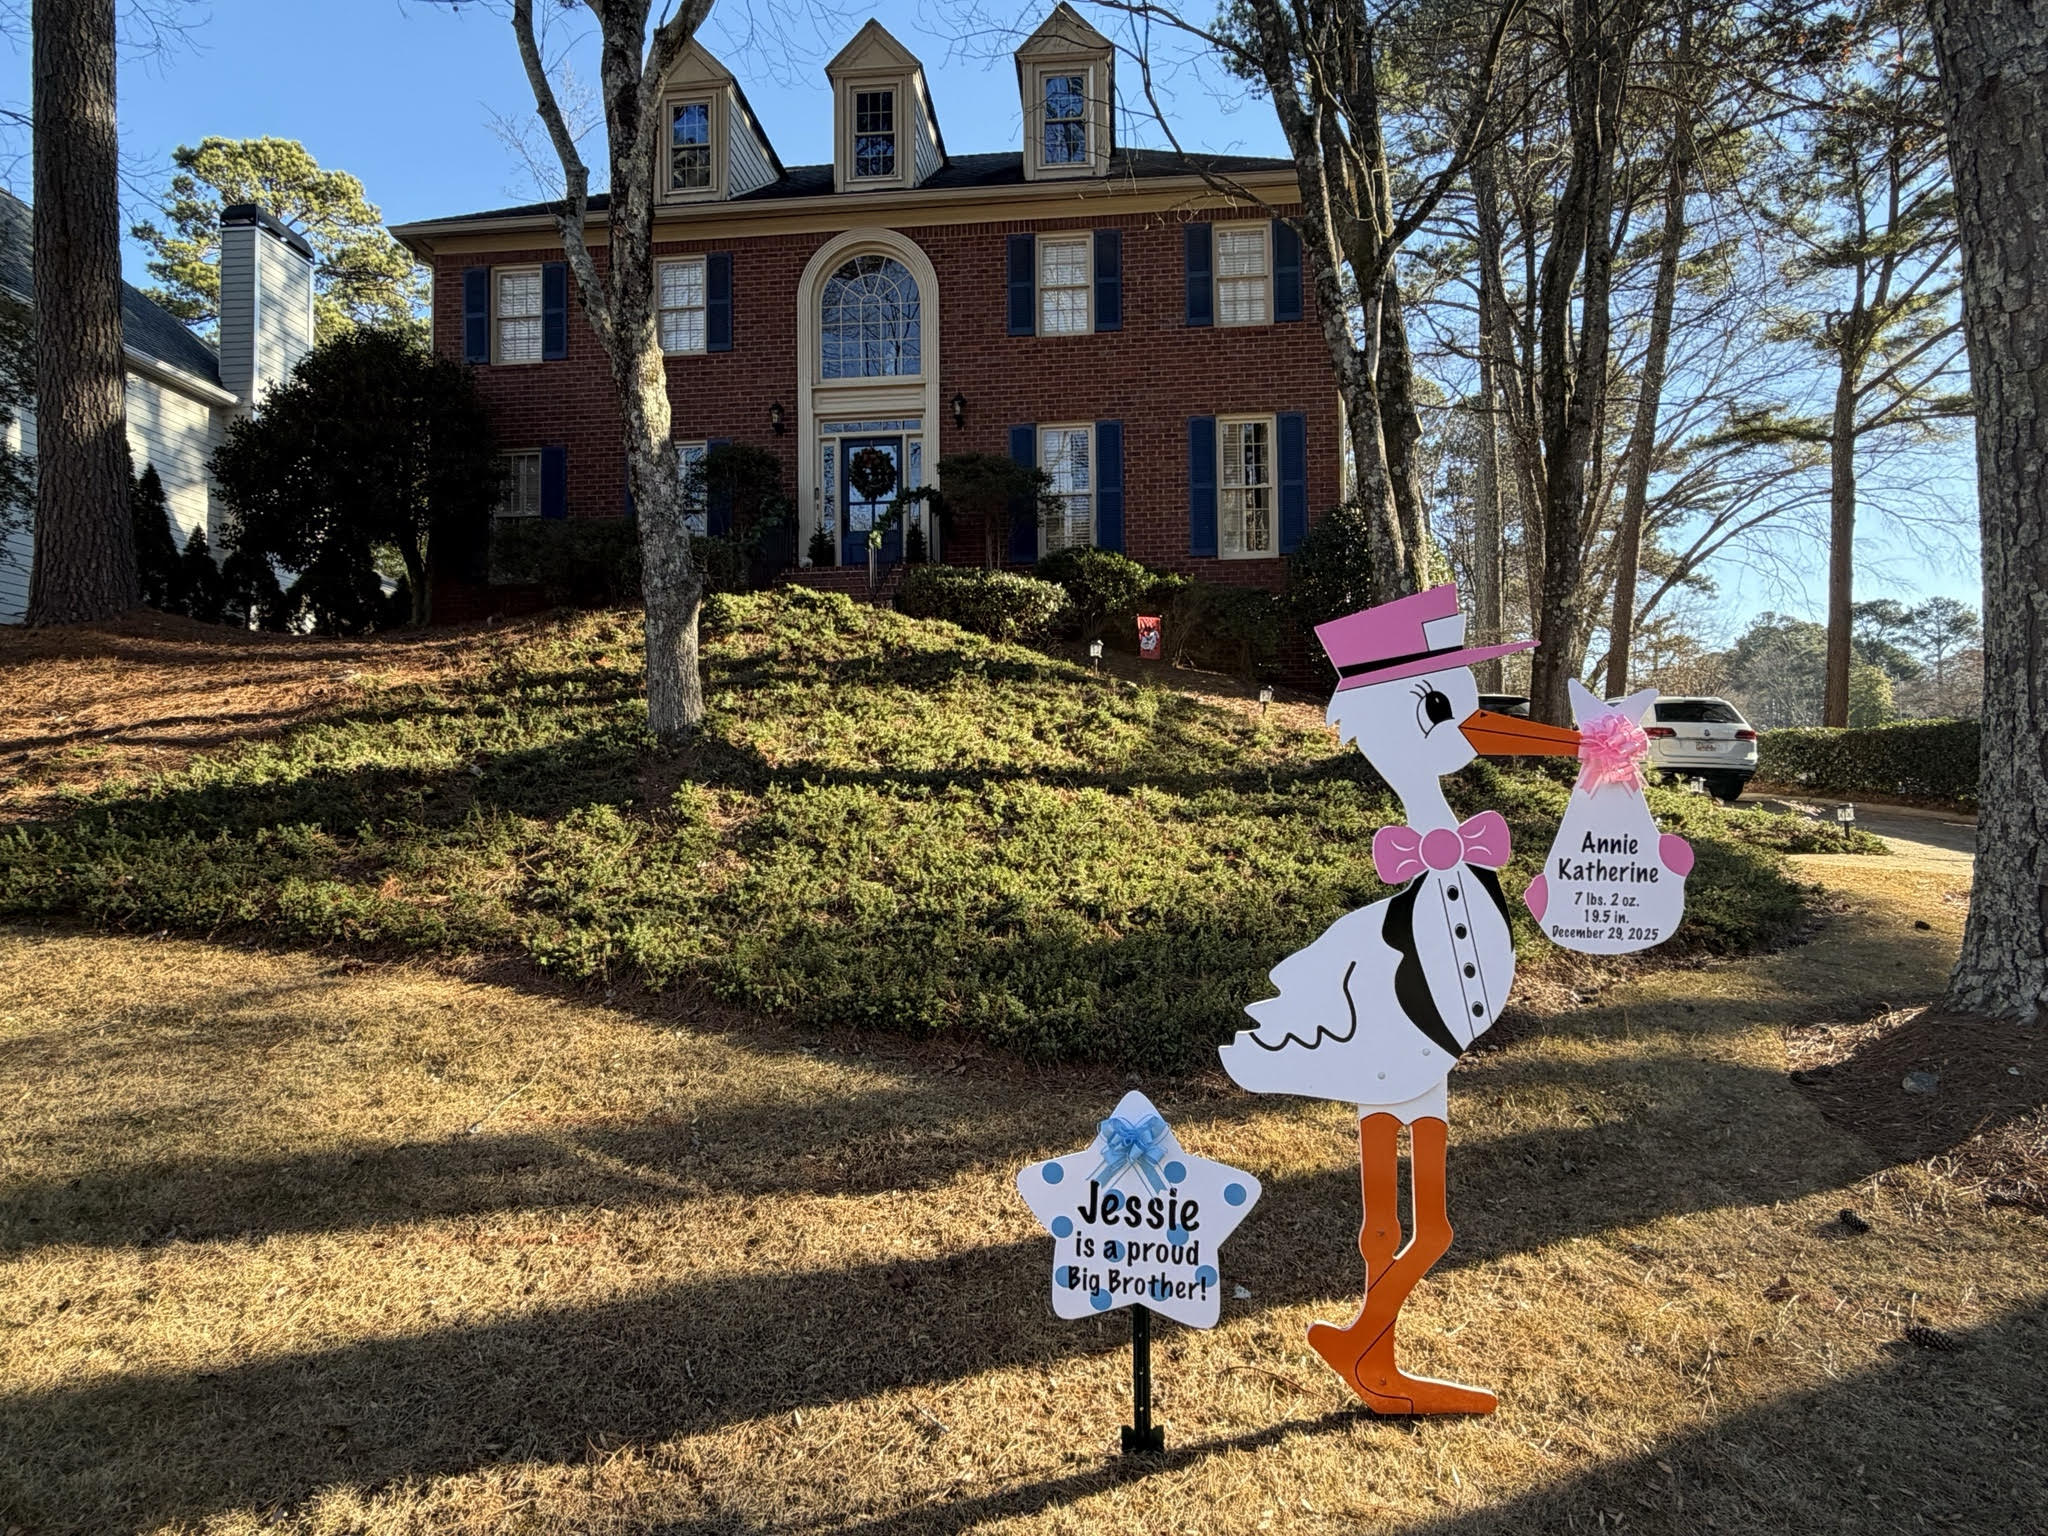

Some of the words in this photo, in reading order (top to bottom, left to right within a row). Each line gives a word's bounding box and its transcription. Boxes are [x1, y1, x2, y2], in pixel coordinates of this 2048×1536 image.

[1581, 831, 1638, 855] Annie
[1558, 857, 1659, 883] Katherine
[1574, 891, 1583, 905] 7
[1586, 892, 1607, 906] lbs.
[1610, 892, 1619, 906] 2
[1622, 896, 1640, 907] oz.
[1584, 909, 1611, 923] 19.5
[1614, 910, 1630, 924] in.
[1552, 925, 1605, 939] December
[1627, 927, 1659, 940] 2025
[1077, 1179, 1200, 1232] Jessie
[1075, 1231, 1095, 1258] is
[1103, 1240, 1118, 1260] a
[1127, 1240, 1200, 1267] proud
[1068, 1265, 1100, 1297] Big
[1108, 1268, 1207, 1301] Brother!
